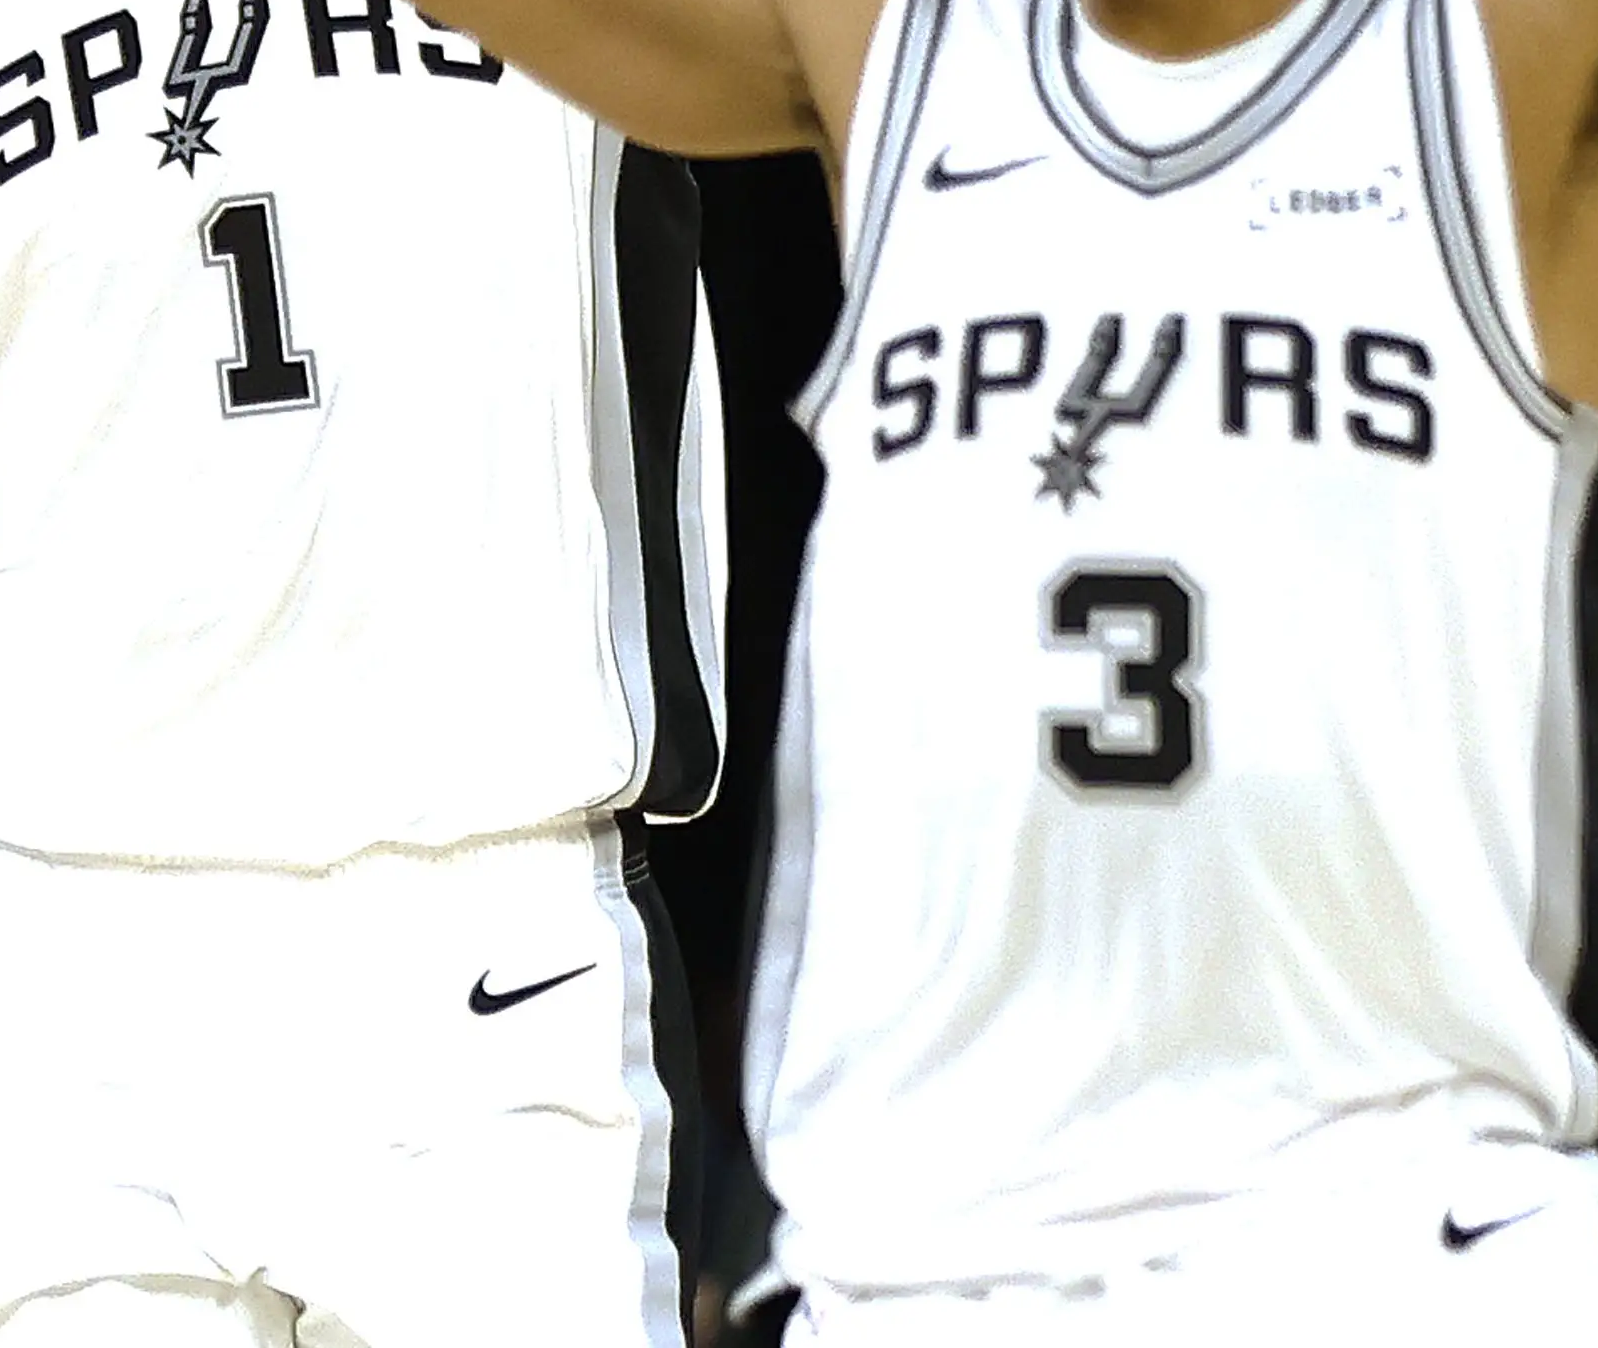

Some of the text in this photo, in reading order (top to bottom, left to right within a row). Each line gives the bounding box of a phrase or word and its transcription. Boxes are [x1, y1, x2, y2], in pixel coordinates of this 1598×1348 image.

[198, 192, 320, 419] 1
[872, 312, 1437, 514] SPURS
[1040, 557, 1207, 794] 3
